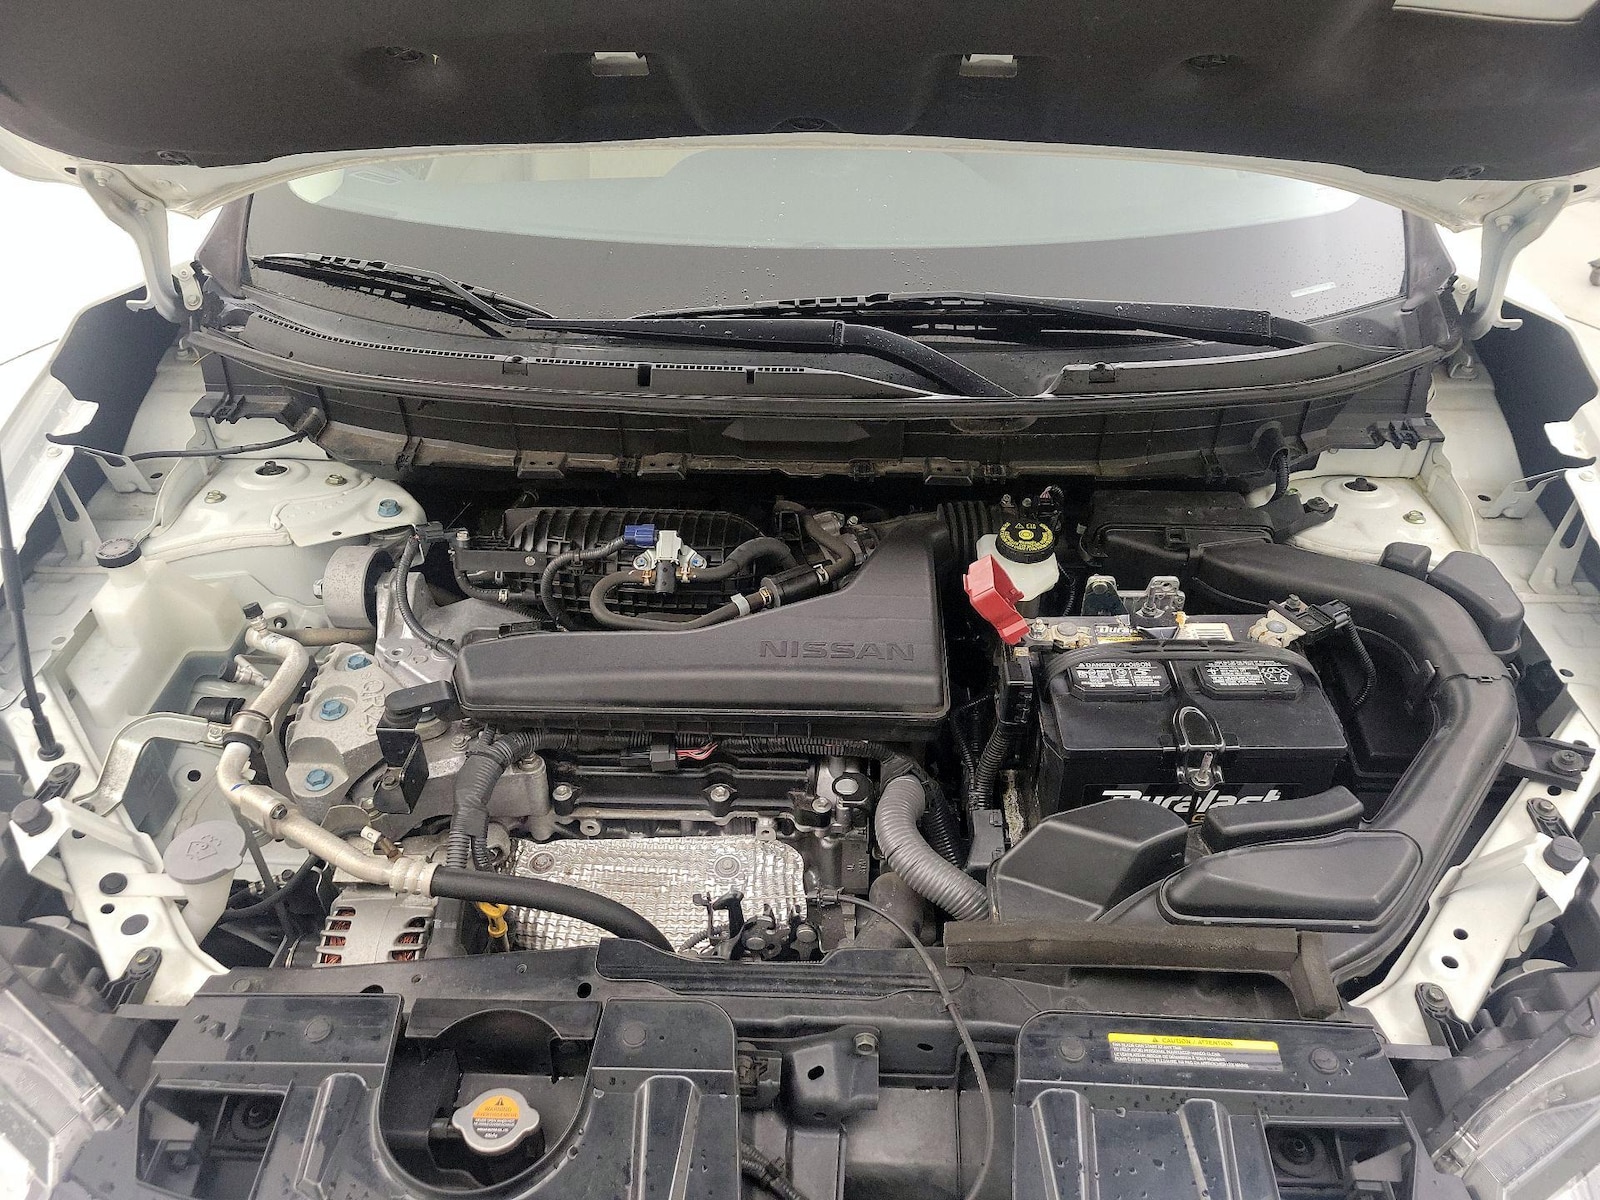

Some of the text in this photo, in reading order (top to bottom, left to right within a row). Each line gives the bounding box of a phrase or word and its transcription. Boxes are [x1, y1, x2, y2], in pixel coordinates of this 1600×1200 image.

[760, 640, 914, 661] NISSAN
[1123, 661, 1152, 669] POISON
[1161, 1037, 1191, 1045] CAUTION
[1198, 1039, 1233, 1047] ATTENTION
